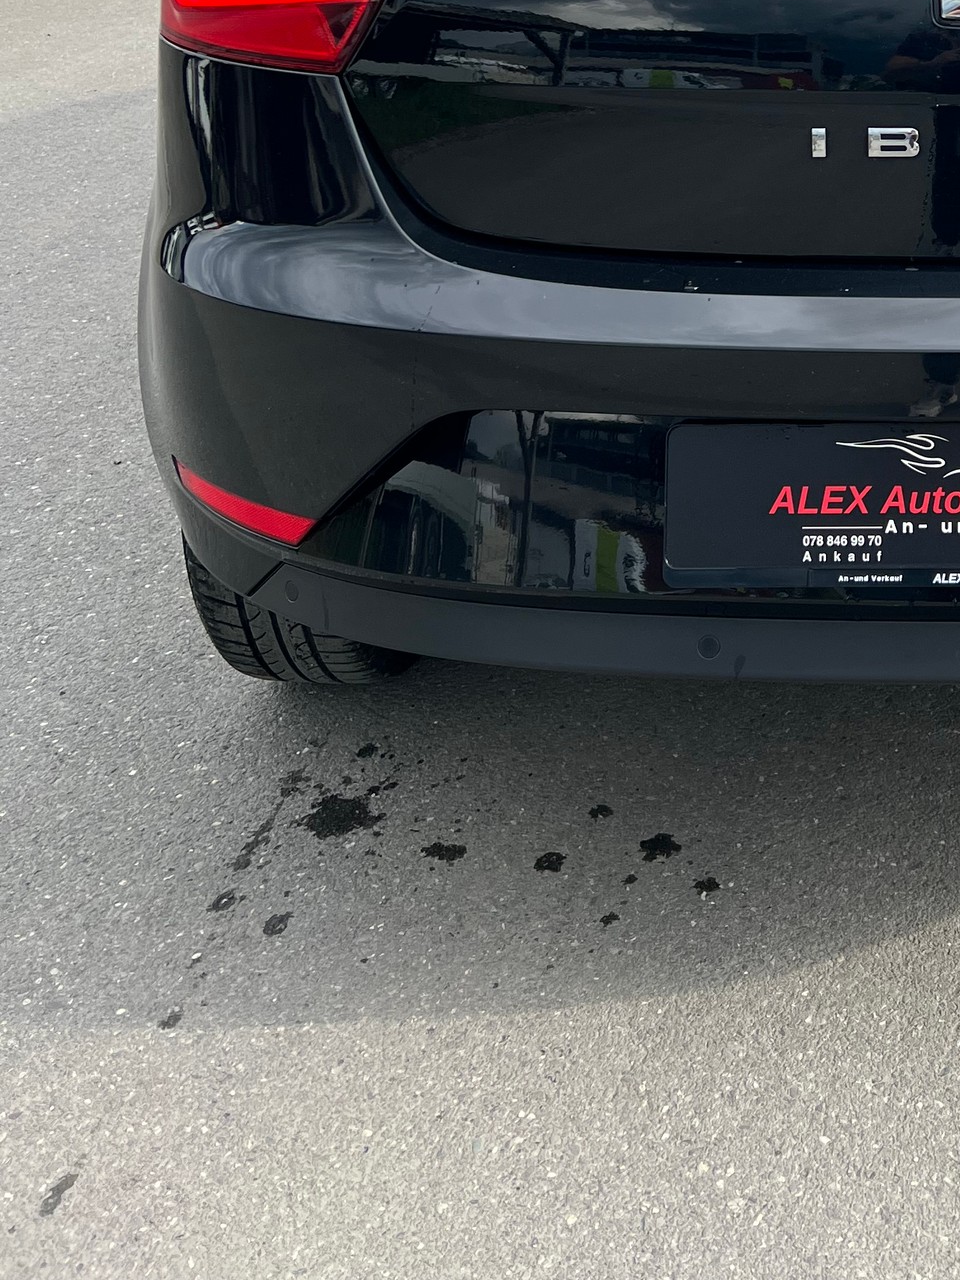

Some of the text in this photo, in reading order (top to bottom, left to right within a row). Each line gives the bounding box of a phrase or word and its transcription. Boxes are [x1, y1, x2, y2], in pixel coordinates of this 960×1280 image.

[768, 485, 872, 515] ALEX
[884, 519, 928, 534] An-
[802, 534, 882, 547] 078 846 99 70
[802, 550, 882, 563] Ankauf
[870, 574, 903, 582] Verkauf
